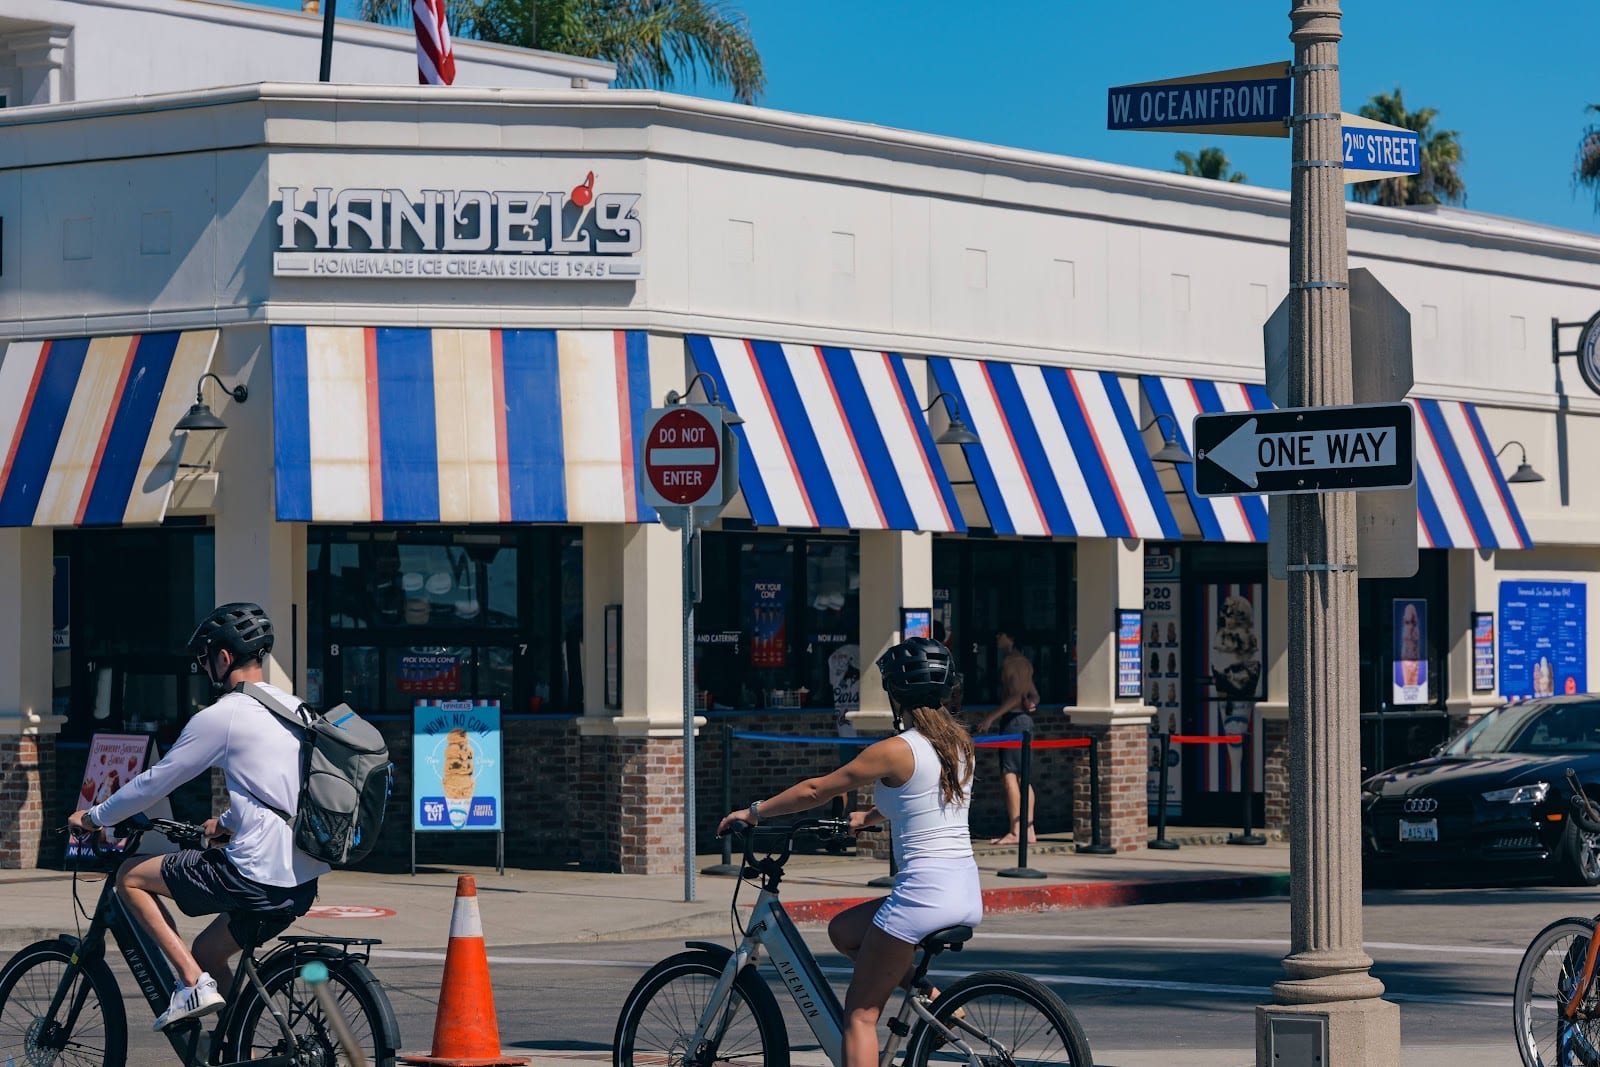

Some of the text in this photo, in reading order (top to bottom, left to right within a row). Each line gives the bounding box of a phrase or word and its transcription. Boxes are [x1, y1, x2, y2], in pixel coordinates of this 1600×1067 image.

[1112, 85, 1277, 124] W. OCEANFRONT
[1367, 134, 1416, 167] STREET
[313, 258, 606, 277] HOMEMADE ICE CREAM SINCE 1945
[659, 427, 706, 443] DO NOT
[1258, 431, 1387, 468] ONE WAY
[663, 470, 702, 486] ENTER
[761, 590, 776, 599] CONE
[1153, 587, 1171, 599] 20
[330, 644, 340, 656] 8
[519, 644, 528, 656] 7
[734, 643, 740, 655] 5
[806, 643, 813, 654] 4
[973, 643, 978, 653] 2
[190, 662, 198, 673] 9
[452, 712, 465, 726] NO
[125, 948, 160, 1001] AVENTON
[779, 961, 819, 1018] AVENTON
